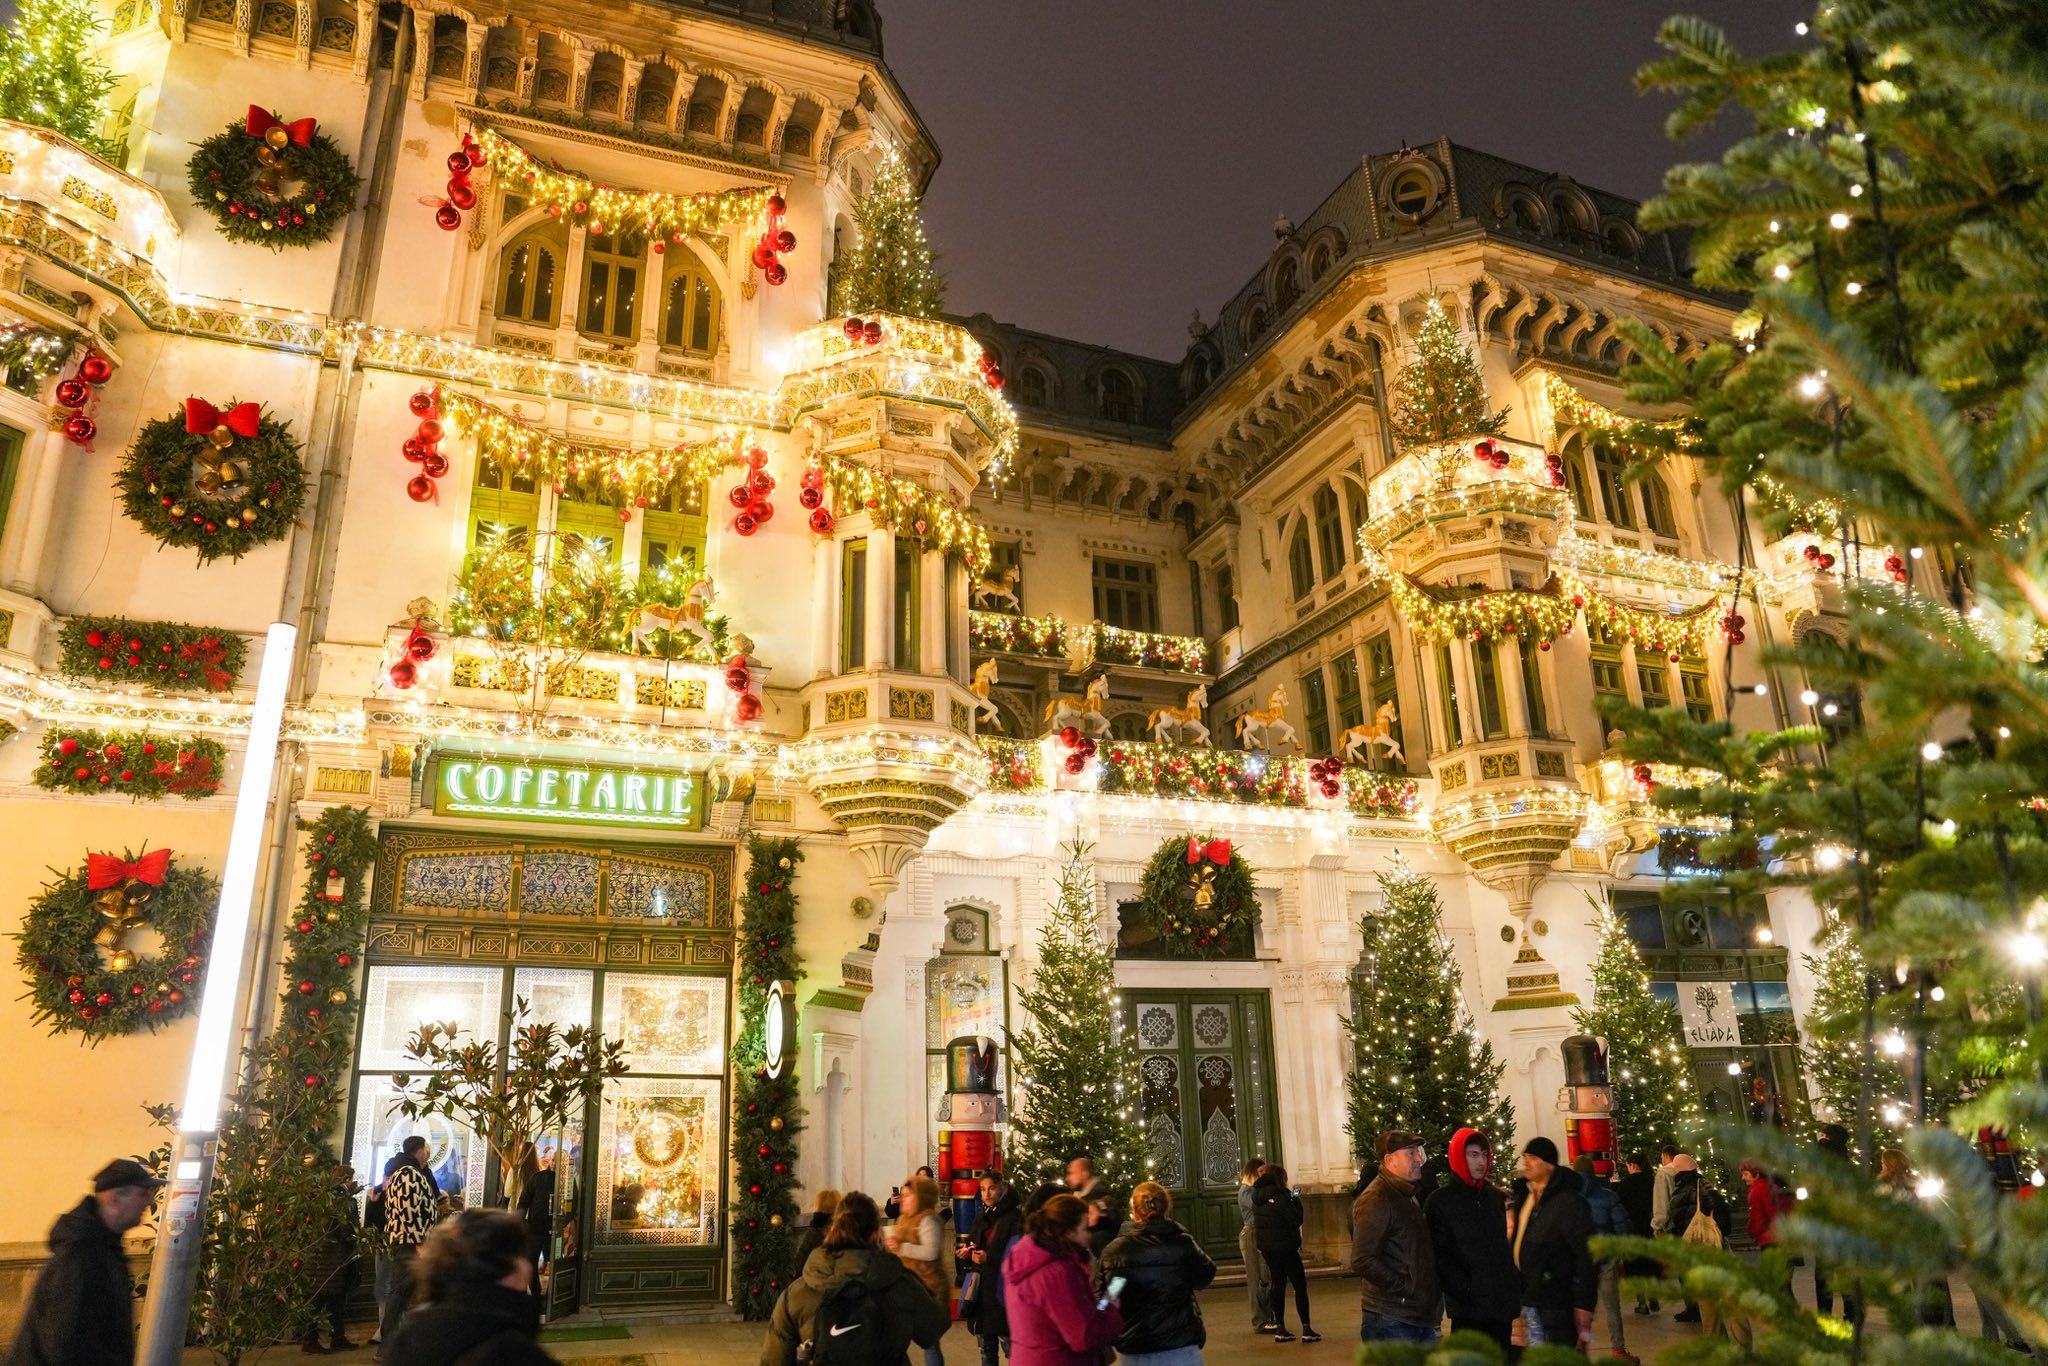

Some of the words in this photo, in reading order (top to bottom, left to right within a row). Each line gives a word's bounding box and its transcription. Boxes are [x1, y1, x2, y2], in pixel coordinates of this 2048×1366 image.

[447, 763, 693, 813] COFETARIE
[426, 1143, 447, 1167] INERVA
[662, 1142, 683, 1165] MINERVA
